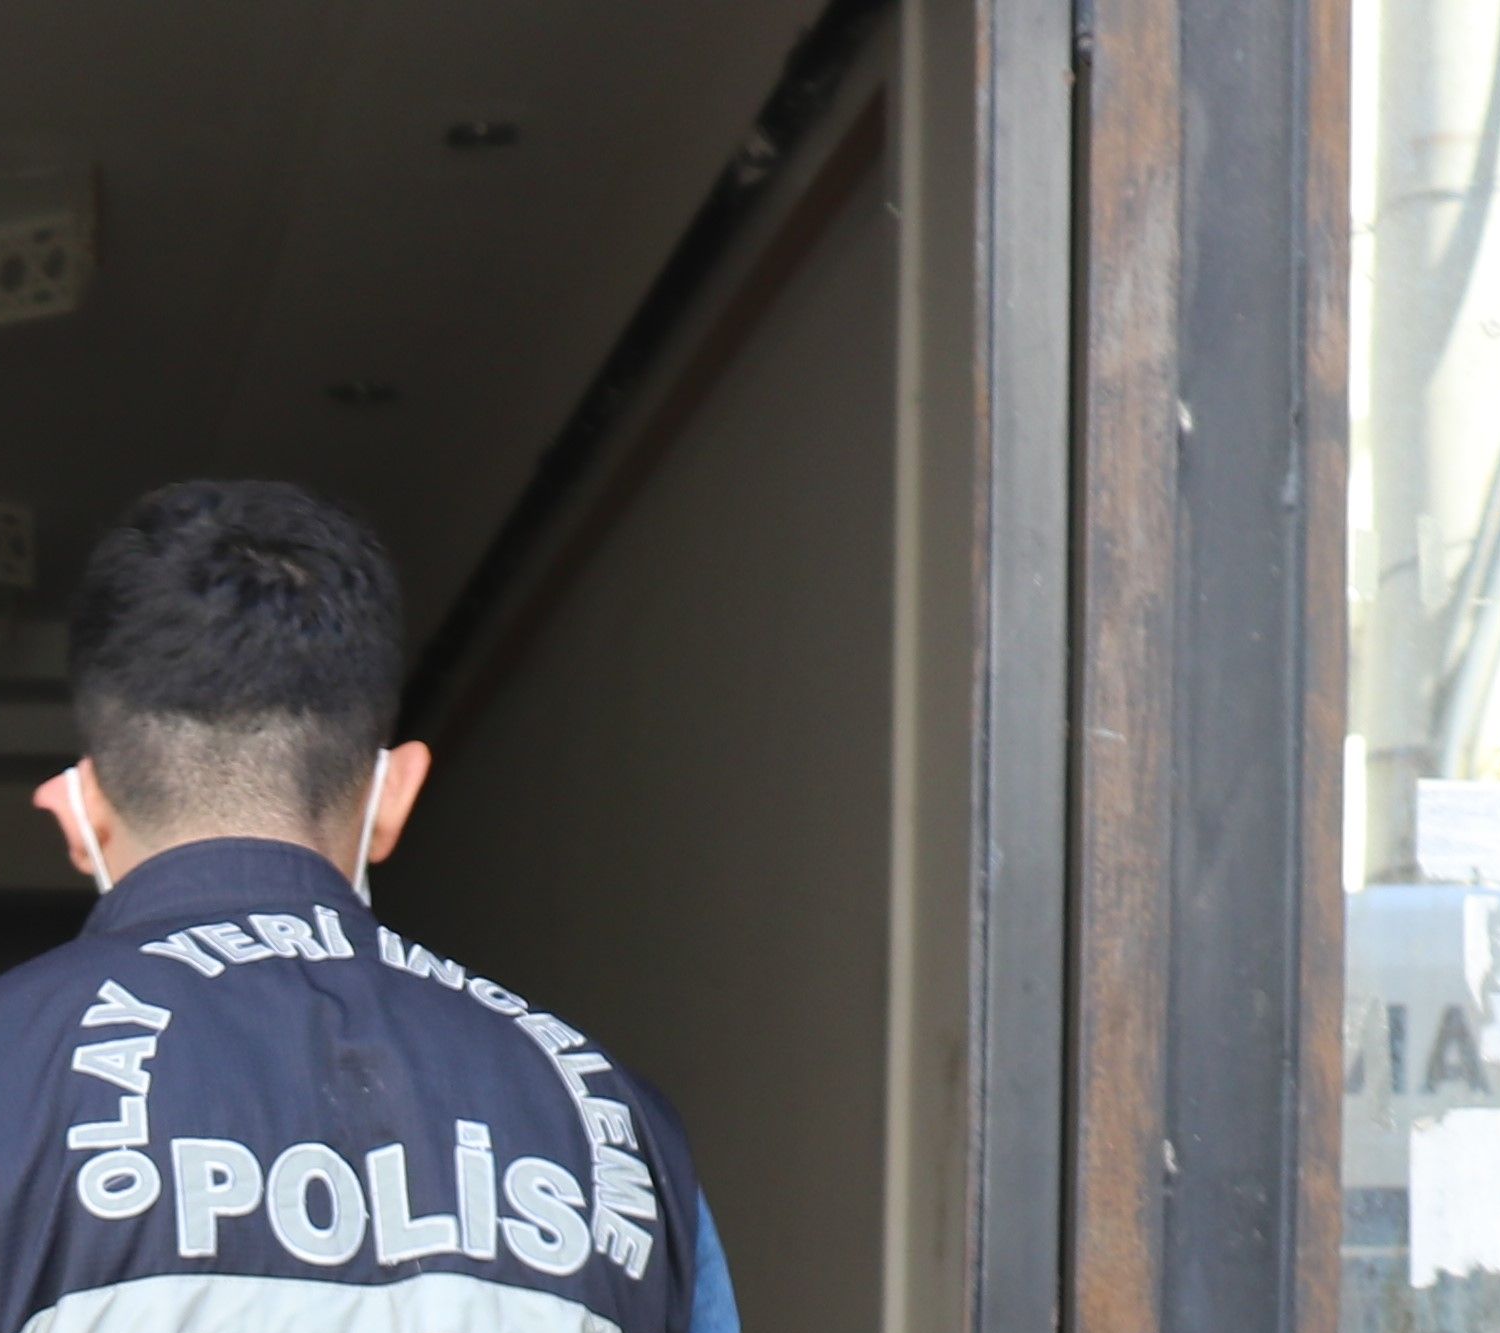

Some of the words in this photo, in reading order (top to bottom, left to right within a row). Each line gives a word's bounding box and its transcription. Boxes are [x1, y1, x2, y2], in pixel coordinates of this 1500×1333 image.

[67, 979, 171, 1219] OLAY
[140, 905, 355, 979] YERİ
[172, 1121, 591, 1276] POLİS
